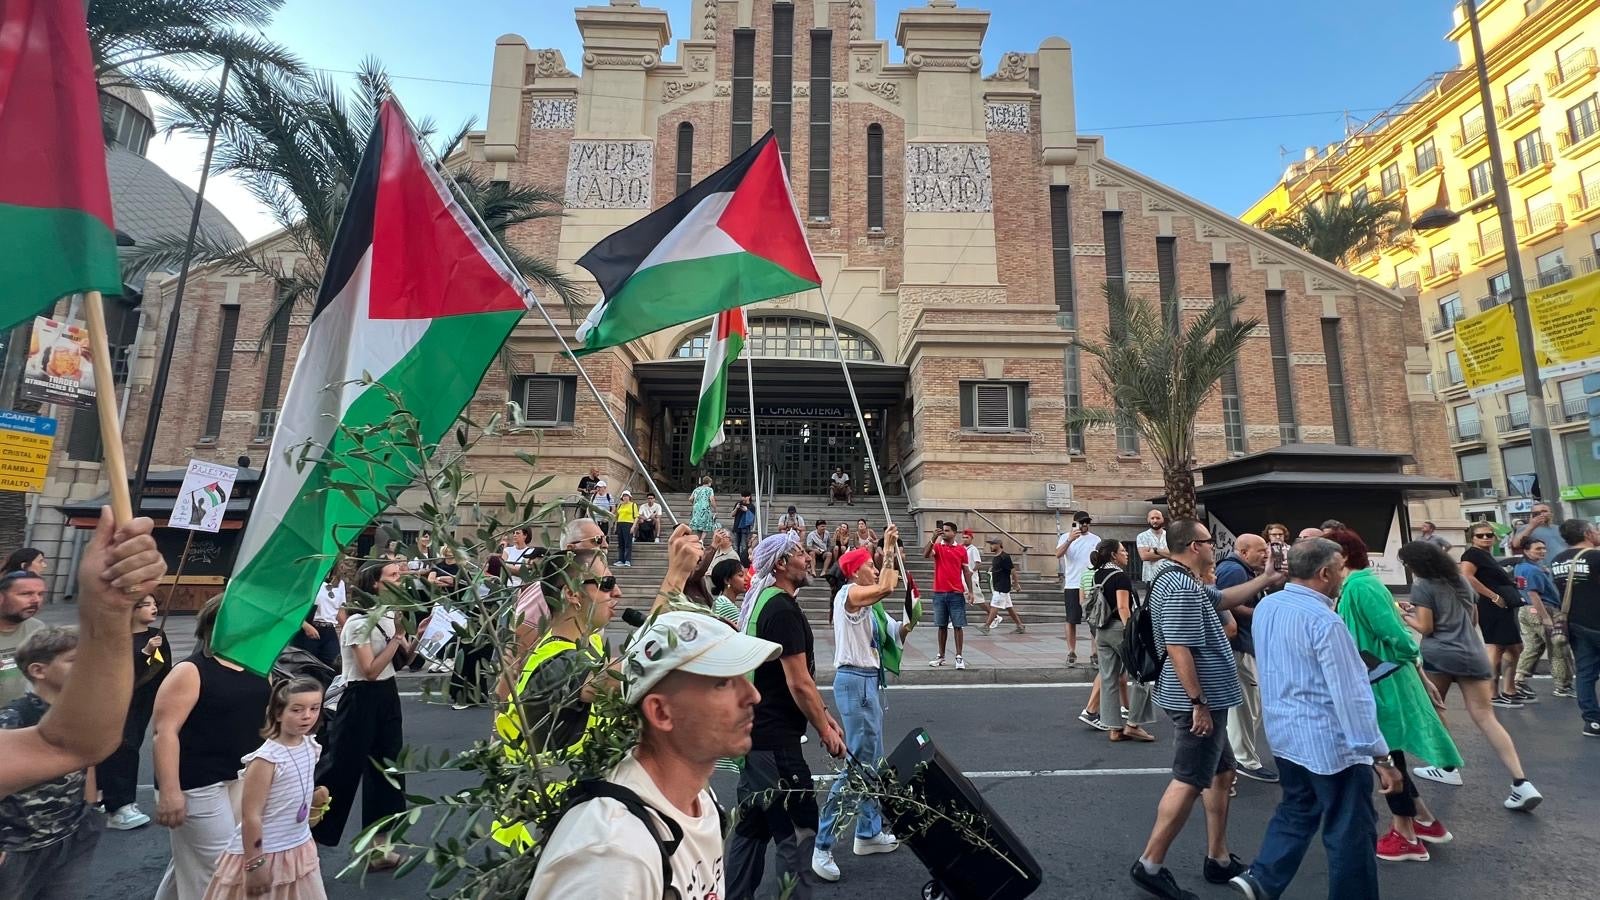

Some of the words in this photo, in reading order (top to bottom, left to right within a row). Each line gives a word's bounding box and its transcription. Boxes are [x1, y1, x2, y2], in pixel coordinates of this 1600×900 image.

[914, 146, 949, 174] DE
[576, 176, 642, 203] CADO
[912, 174, 987, 205] BASTOS
[1, 463, 35, 473] RAMBLA
[1, 478, 30, 488] RIALTO
